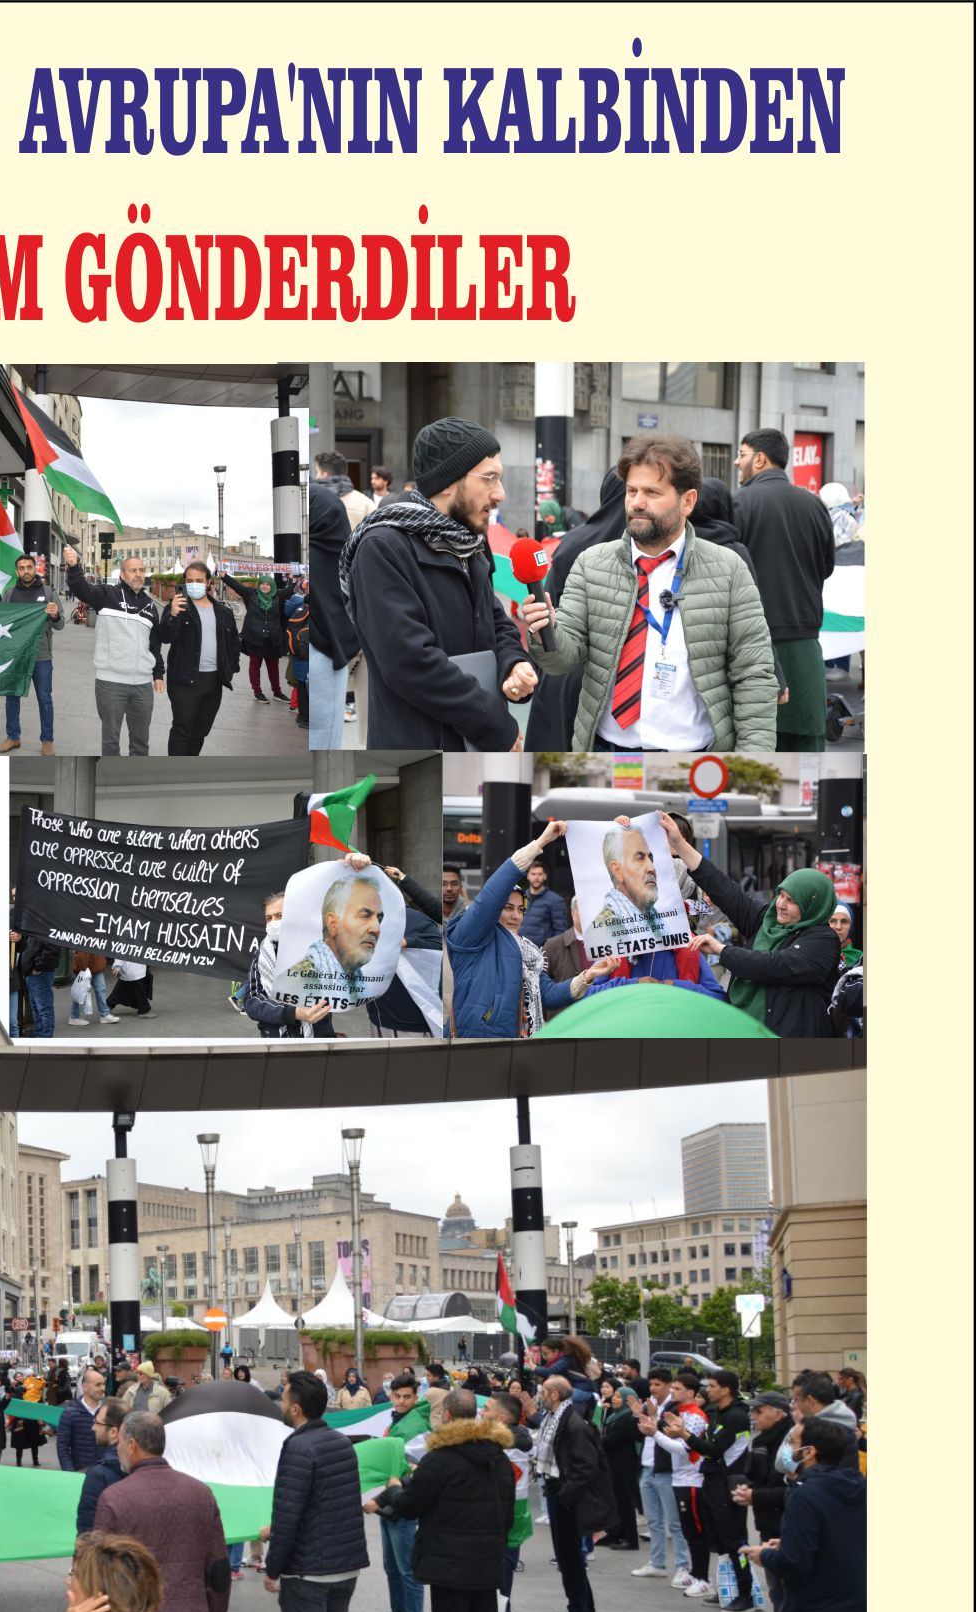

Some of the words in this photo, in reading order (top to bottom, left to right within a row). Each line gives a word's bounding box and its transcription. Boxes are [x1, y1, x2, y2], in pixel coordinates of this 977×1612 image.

[238, 563, 293, 573] PALESTINE
[28, 807, 64, 833] Those
[97, 828, 121, 845] are
[126, 830, 164, 850] silent
[30, 840, 60, 860] are
[138, 860, 167, 878] are
[593, 921, 603, 929] Le
[605, 914, 637, 927] Général
[157, 922, 245, 953] HUSSAIN
[612, 925, 650, 937] assassiné
[651, 923, 665, 933] par
[590, 944, 612, 959] LES
[617, 932, 690, 955] ÉTATS-UNIS
[111, 941, 143, 958] YOUTH
[144, 947, 191, 966] BELGIUM
[287, 969, 298, 978] Le
[300, 969, 337, 980] Général
[303, 982, 347, 992] assassiné
[349, 986, 366, 994] par
[275, 991, 299, 1005] LES
